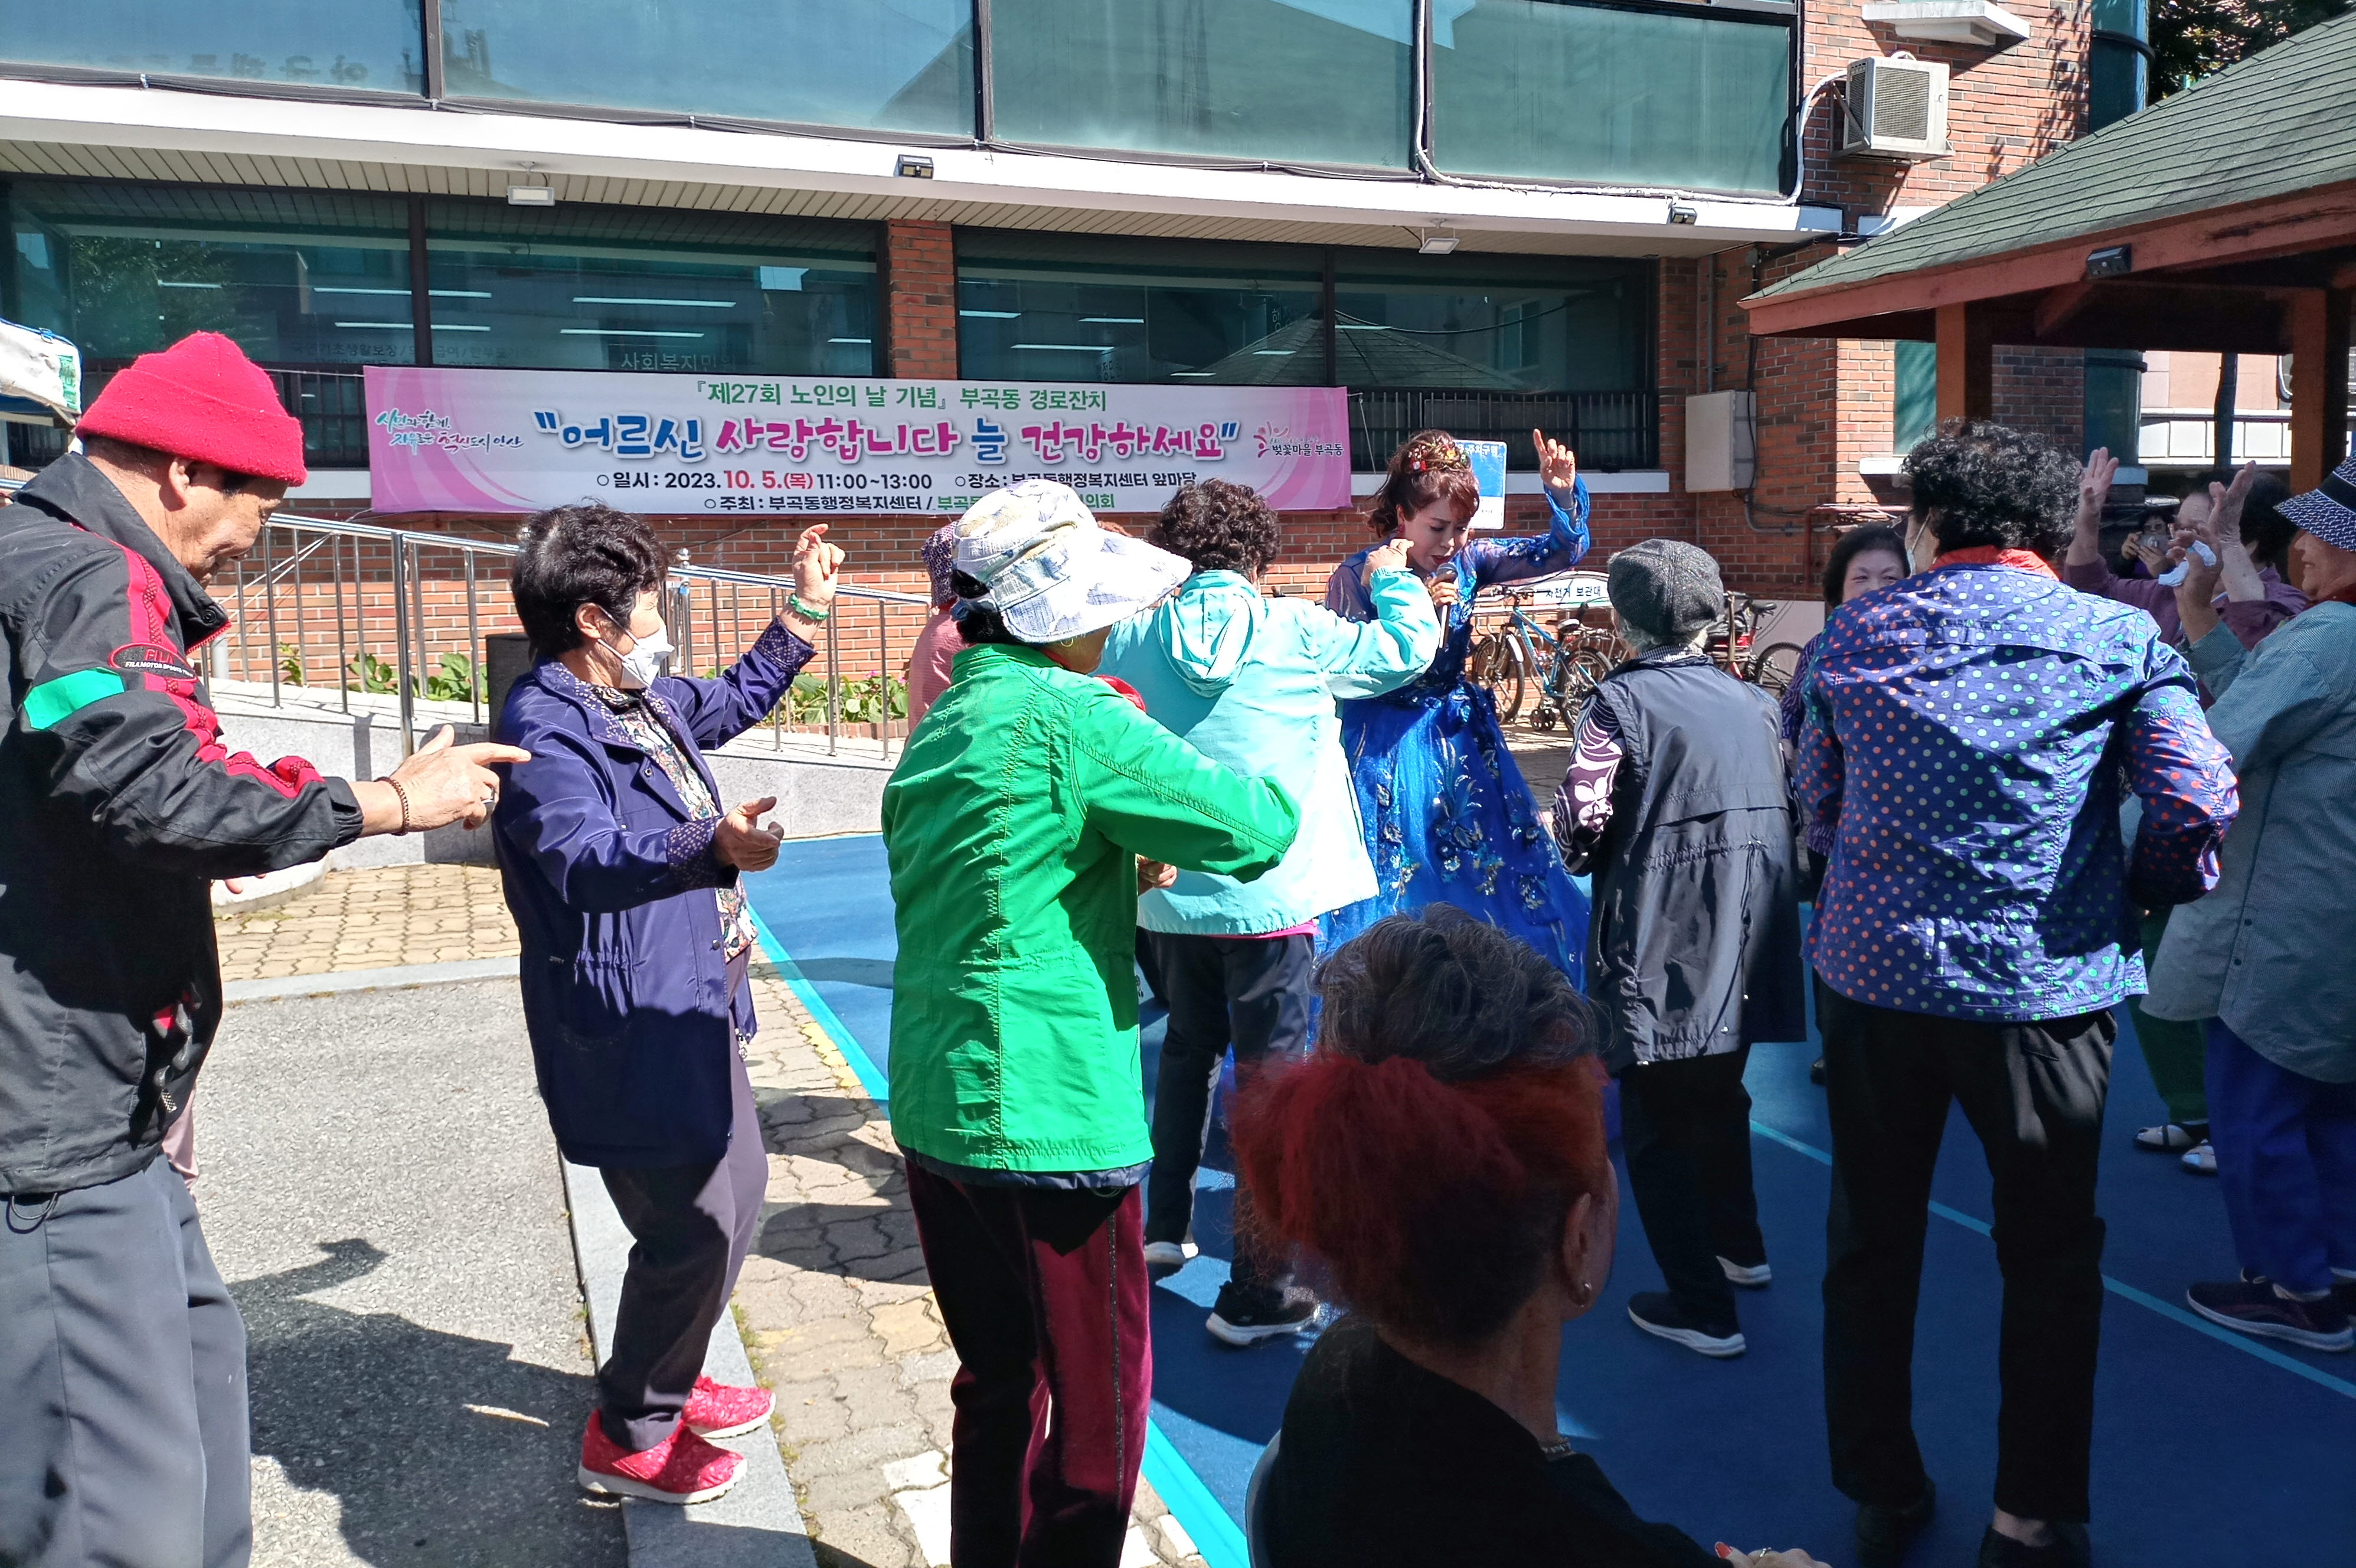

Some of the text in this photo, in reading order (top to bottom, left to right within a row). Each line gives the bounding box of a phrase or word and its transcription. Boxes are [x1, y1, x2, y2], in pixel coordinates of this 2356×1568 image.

[790, 384, 857, 407] 노인의
[865, 386, 887, 407] 날
[960, 387, 1021, 410] 부곡동
[1030, 389, 1107, 411] 경로잔치
[715, 417, 958, 460] 사랑합니다
[971, 417, 1005, 461] 늘
[1272, 443, 1344, 456] 벚꽃마을 부곡동
[816, 473, 932, 489] 11:00~13:00
[1152, 472, 1197, 486] 앞마당
[769, 496, 922, 510] 부곡동행정복지센터
[1545, 586, 1601, 598] 자전거 보관대
[145, 649, 174, 664] FILA
